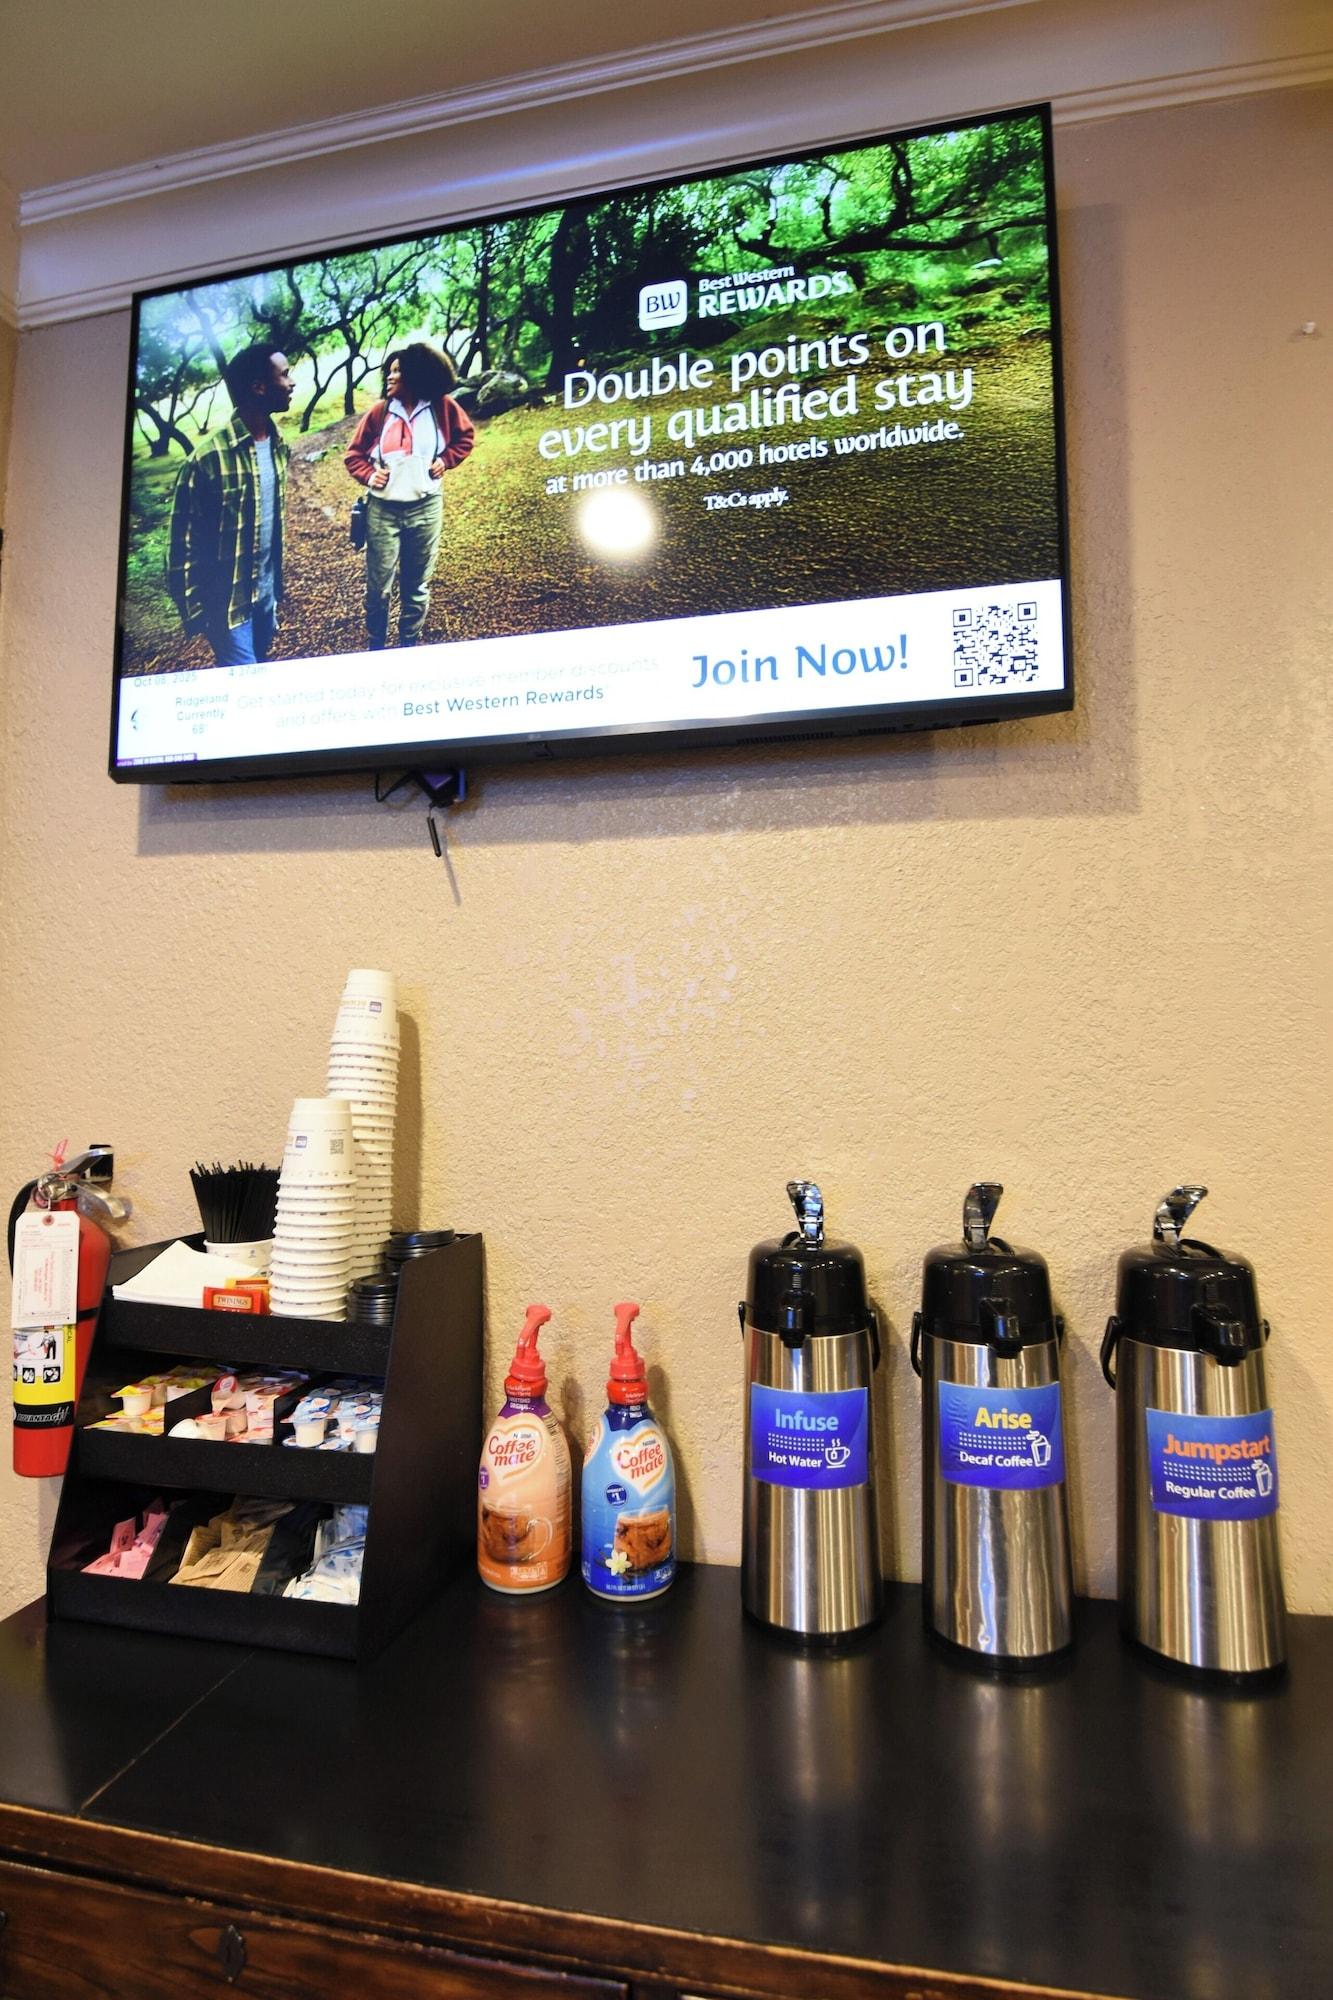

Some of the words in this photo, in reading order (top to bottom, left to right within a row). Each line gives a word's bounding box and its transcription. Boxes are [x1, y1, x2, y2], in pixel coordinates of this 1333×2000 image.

[699, 275, 732, 292] Best
[733, 266, 795, 287] Western
[647, 292, 680, 313] BW
[564, 356, 713, 410] Double
[731, 333, 869, 390] points
[885, 321, 947, 359] on
[538, 416, 651, 459] every
[667, 383, 857, 448] qualified
[874, 367, 976, 412] stay
[545, 474, 567, 495] at
[573, 468, 627, 490] more
[634, 457, 685, 483] than
[690, 448, 753, 478] 4,000
[759, 437, 829, 464] hotels
[834, 419, 965, 455] worldwide.
[703, 492, 747, 511] T&Cs
[749, 486, 789, 508] apply.
[692, 649, 778, 688] Join
[795, 634, 907, 678] Now!
[175, 692, 229, 709] Ridgeland
[403, 702, 440, 716] Best
[446, 694, 519, 712] Western
[526, 685, 604, 706] Rewards
[177, 708, 225, 721] Currently
[216, 1296, 249, 1306] TWININGS
[775, 1408, 839, 1432] Infuse
[975, 1407, 1032, 1430] Arise
[488, 1436, 535, 1455] Coffee
[617, 1444, 662, 1469] Coffee
[1162, 1433, 1271, 1465] Jumpstart
[494, 1450, 535, 1467] mate
[631, 1454, 664, 1479] mate
[768, 1451, 788, 1466] Hot
[788, 1453, 823, 1469] Water
[959, 1451, 993, 1467] Decaf
[996, 1452, 1034, 1468] Coffee
[1166, 1481, 1216, 1499] Regular
[1218, 1487, 1257, 1499] Coffee
